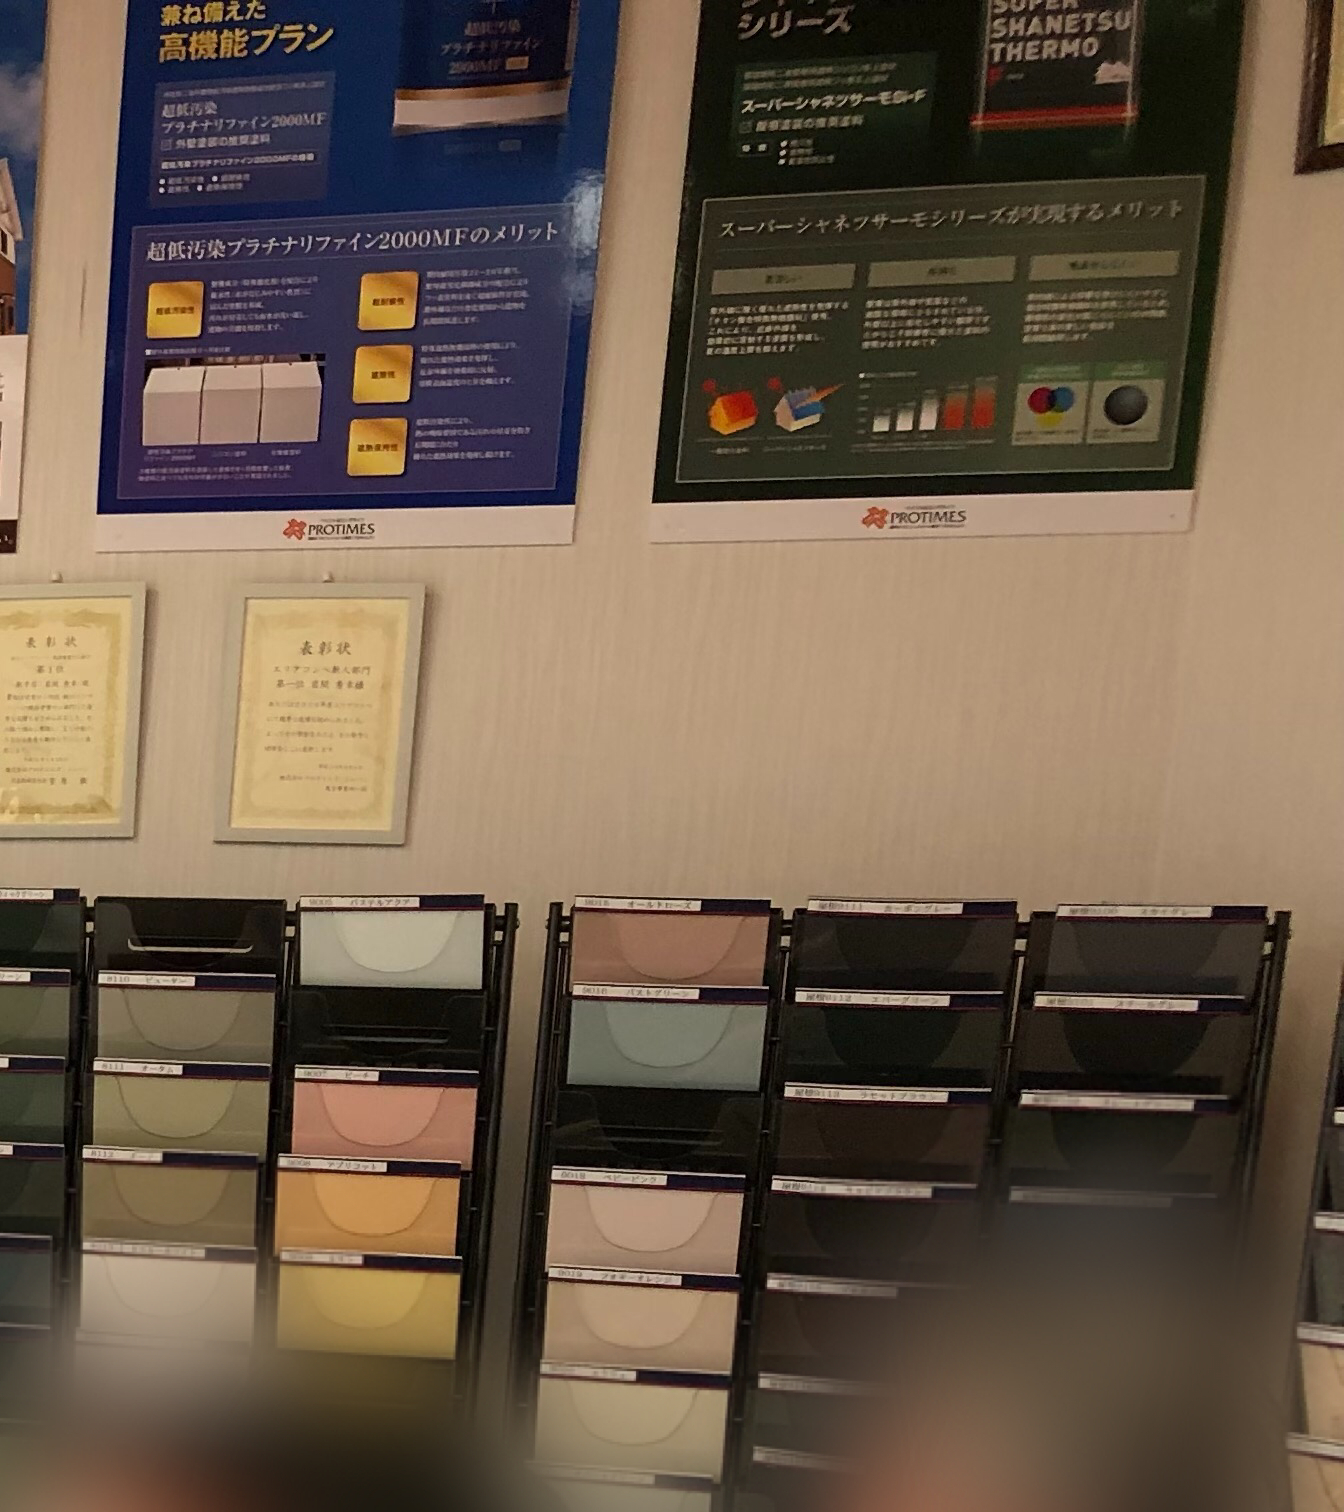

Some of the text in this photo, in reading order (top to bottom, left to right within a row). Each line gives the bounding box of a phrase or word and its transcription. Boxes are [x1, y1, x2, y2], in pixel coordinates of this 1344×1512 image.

[160, 2, 266, 27] 兼ね備えた
[737, 5, 852, 41] シリーズ
[990, 9, 1132, 39] SHANETSU
[159, 24, 335, 63] 高機能プラン
[990, 37, 1100, 63] THERMO
[161, 113, 326, 135] プラチナリファイン2000MF
[147, 223, 560, 262] 超低汚染プラチナリファイン2000MFのメリット
[308, 522, 376, 536] PROTIMES
[889, 509, 967, 527] PROTIMES
[299, 640, 353, 657] 表彰状
